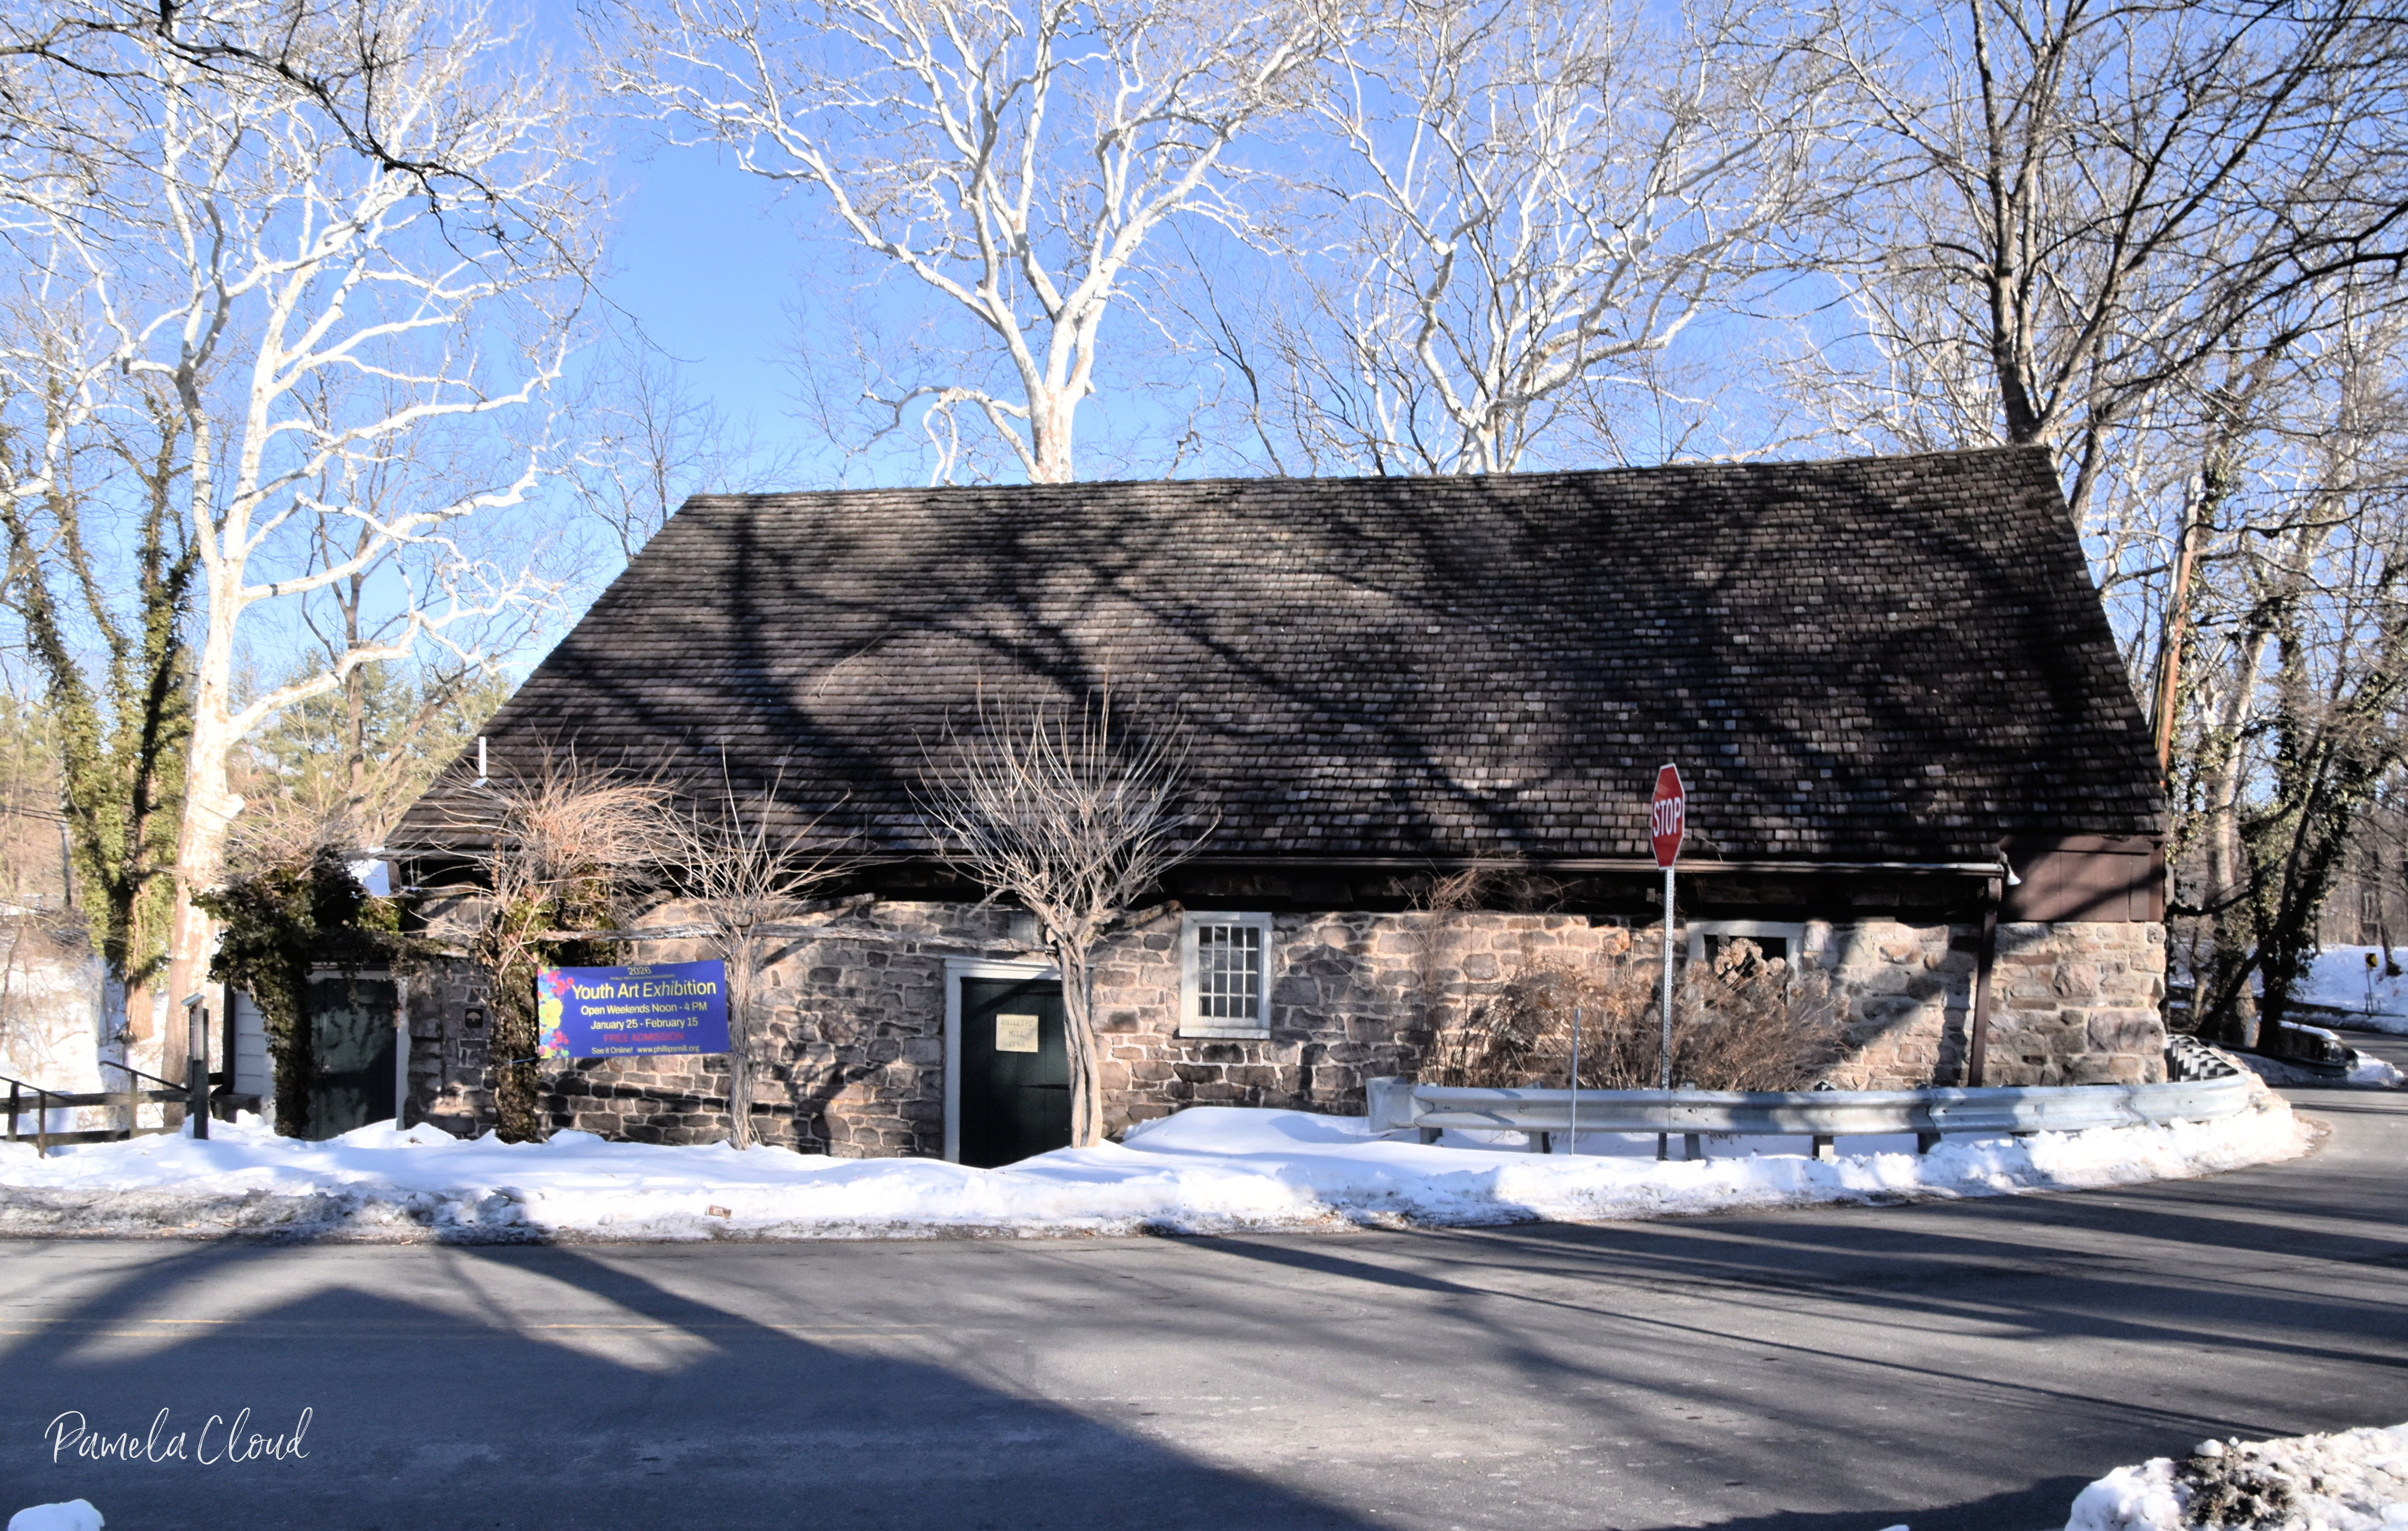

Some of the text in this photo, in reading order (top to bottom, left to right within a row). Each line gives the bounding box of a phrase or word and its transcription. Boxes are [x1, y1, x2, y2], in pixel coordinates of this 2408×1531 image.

[1653, 797, 1681, 838] STOP
[627, 966, 651, 975] 2026
[572, 979, 716, 1000] Youth Art Exhibition
[581, 1005, 605, 1017] Open
[607, 1004, 650, 1014] Weekends
[652, 1004, 677, 1013] Noon
[684, 1003, 690, 1011] 4
[692, 1001, 707, 1011] PM
[591, 1021, 624, 1030] January
[626, 1019, 638, 1028] 25
[645, 1018, 685, 1028] February
[687, 1017, 698, 1026] 15
[604, 1032, 684, 1042] FREE ADMISSION
[637, 1045, 700, 1054] www.phillipsmill.org
